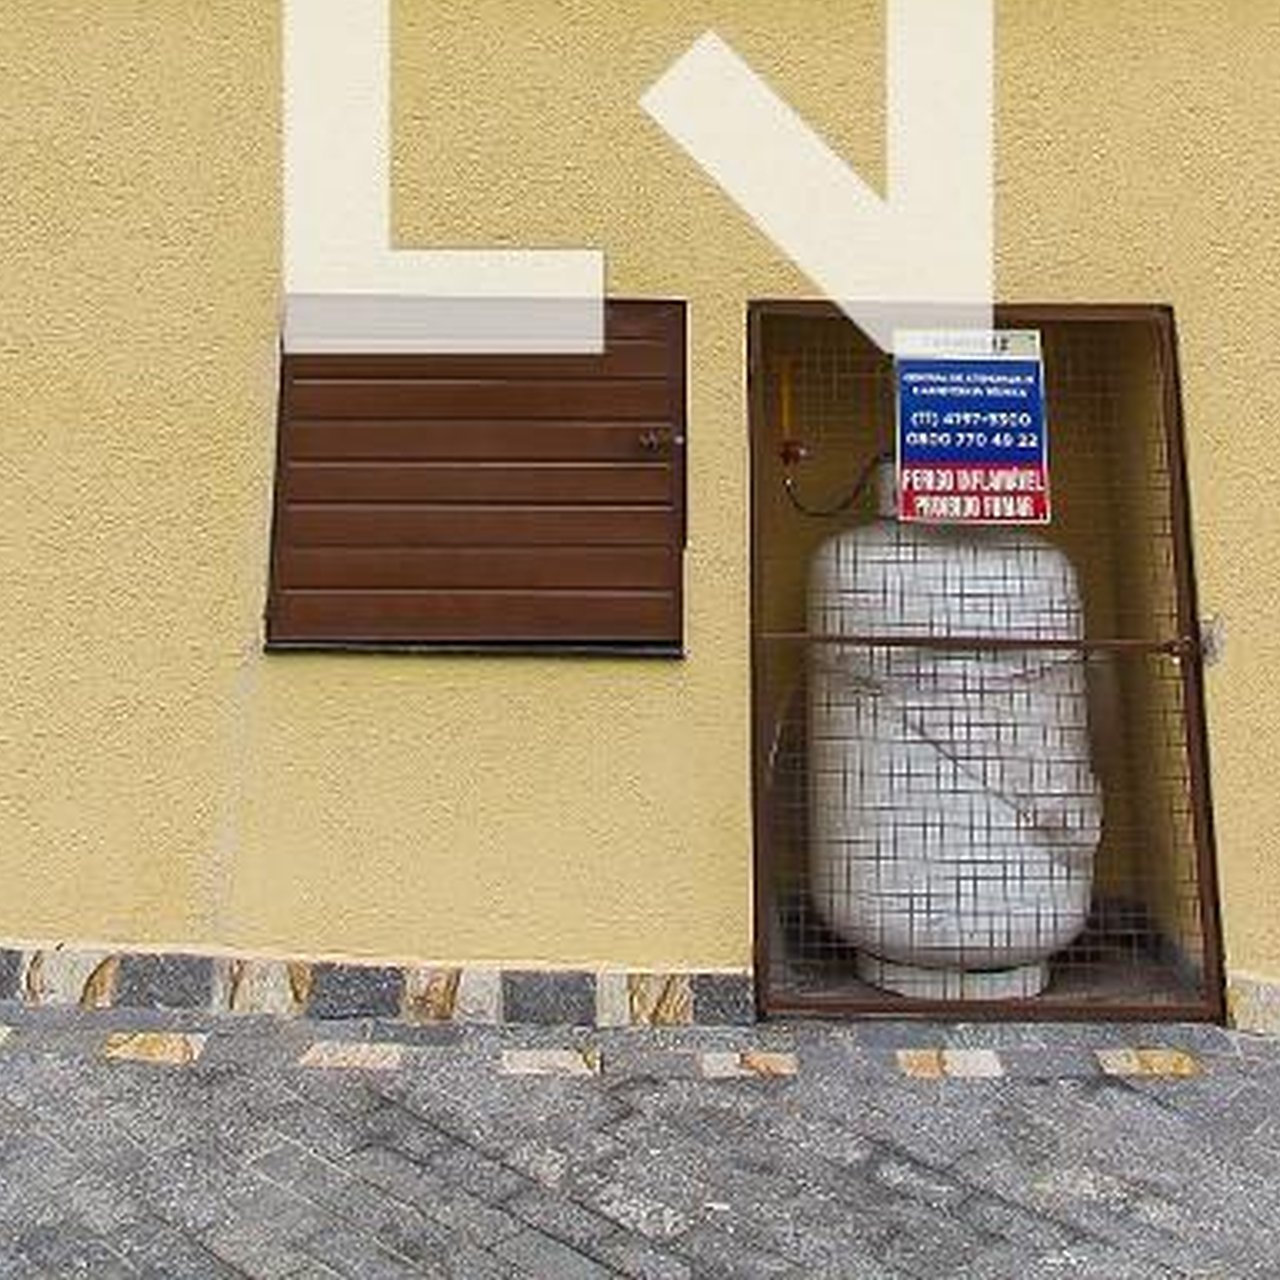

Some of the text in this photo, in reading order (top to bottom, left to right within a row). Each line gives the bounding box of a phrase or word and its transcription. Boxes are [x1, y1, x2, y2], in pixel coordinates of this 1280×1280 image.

[911, 412, 938, 428] (11)
[1017, 432, 1038, 447] 22
[903, 469, 953, 491] PERIGO
[915, 495, 1034, 517] PROIBIDO FUMAR
